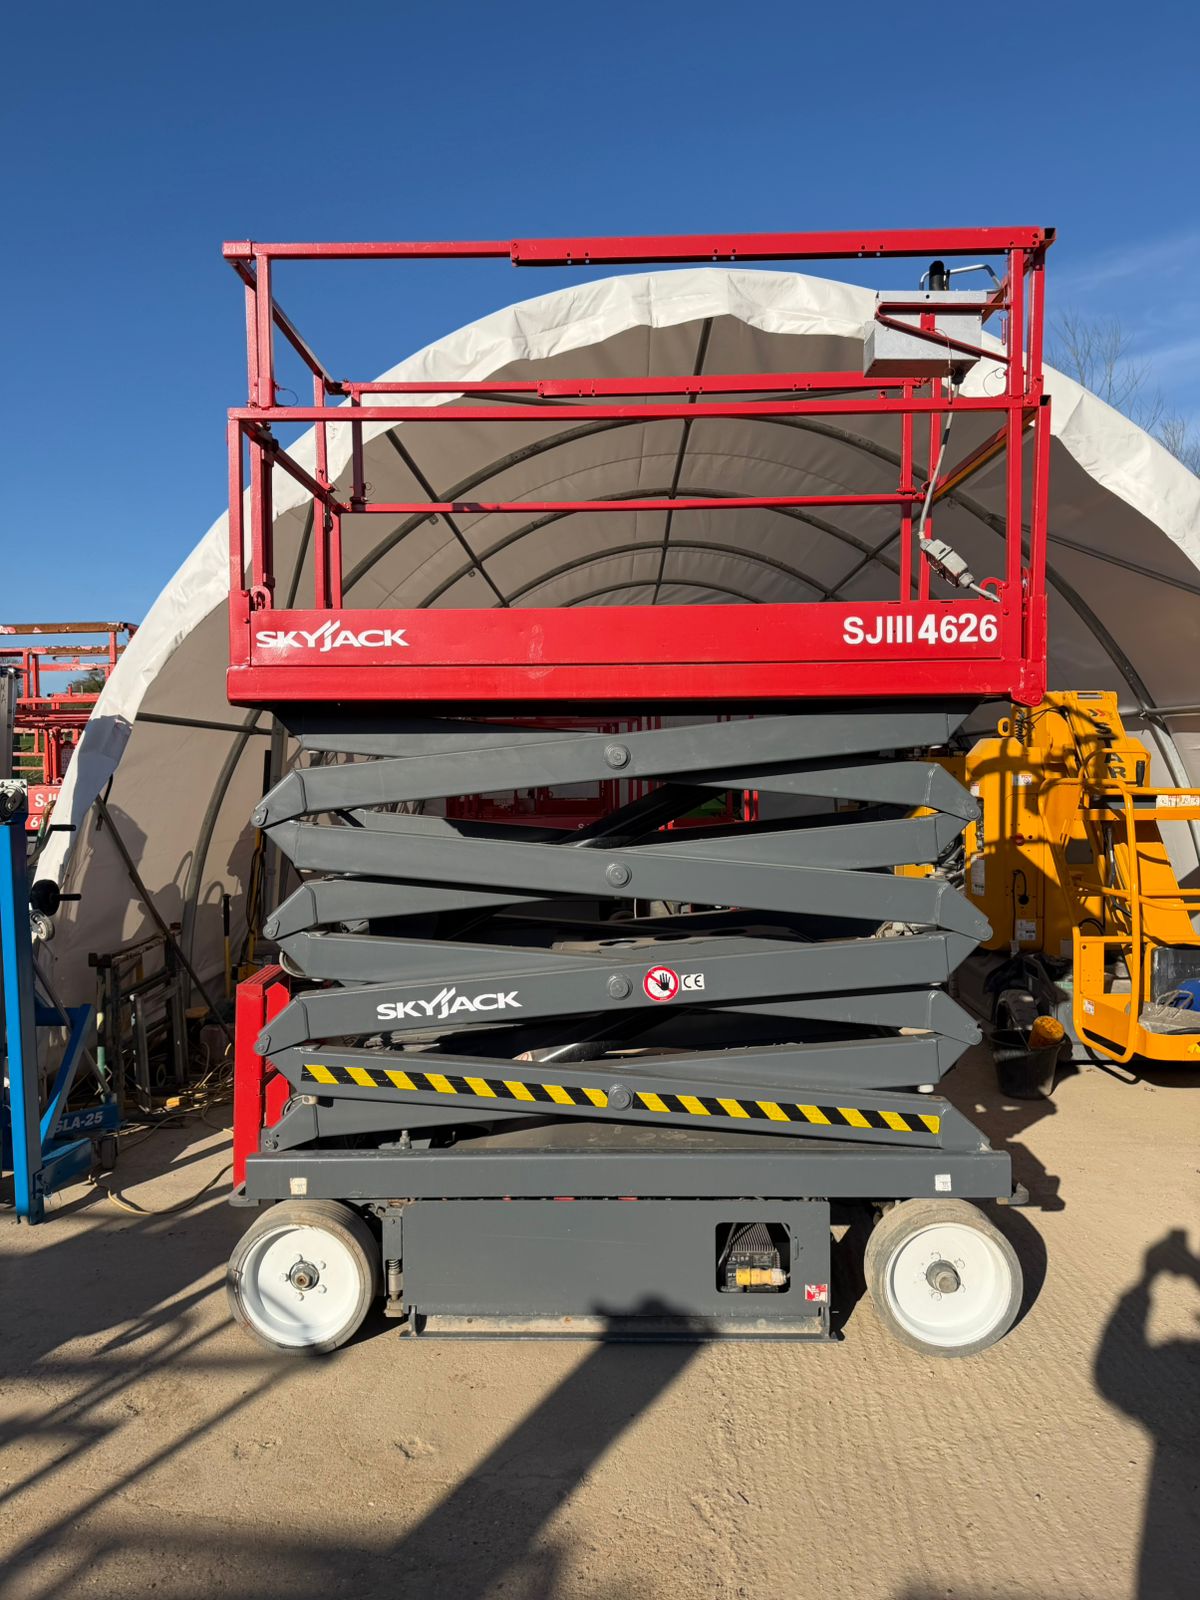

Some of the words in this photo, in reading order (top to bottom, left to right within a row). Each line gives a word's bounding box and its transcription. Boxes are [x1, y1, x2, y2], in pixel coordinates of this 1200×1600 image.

[255, 619, 410, 653] SKYJACK
[917, 612, 998, 645] 4626
[376, 986, 523, 1020] SKYJACK
